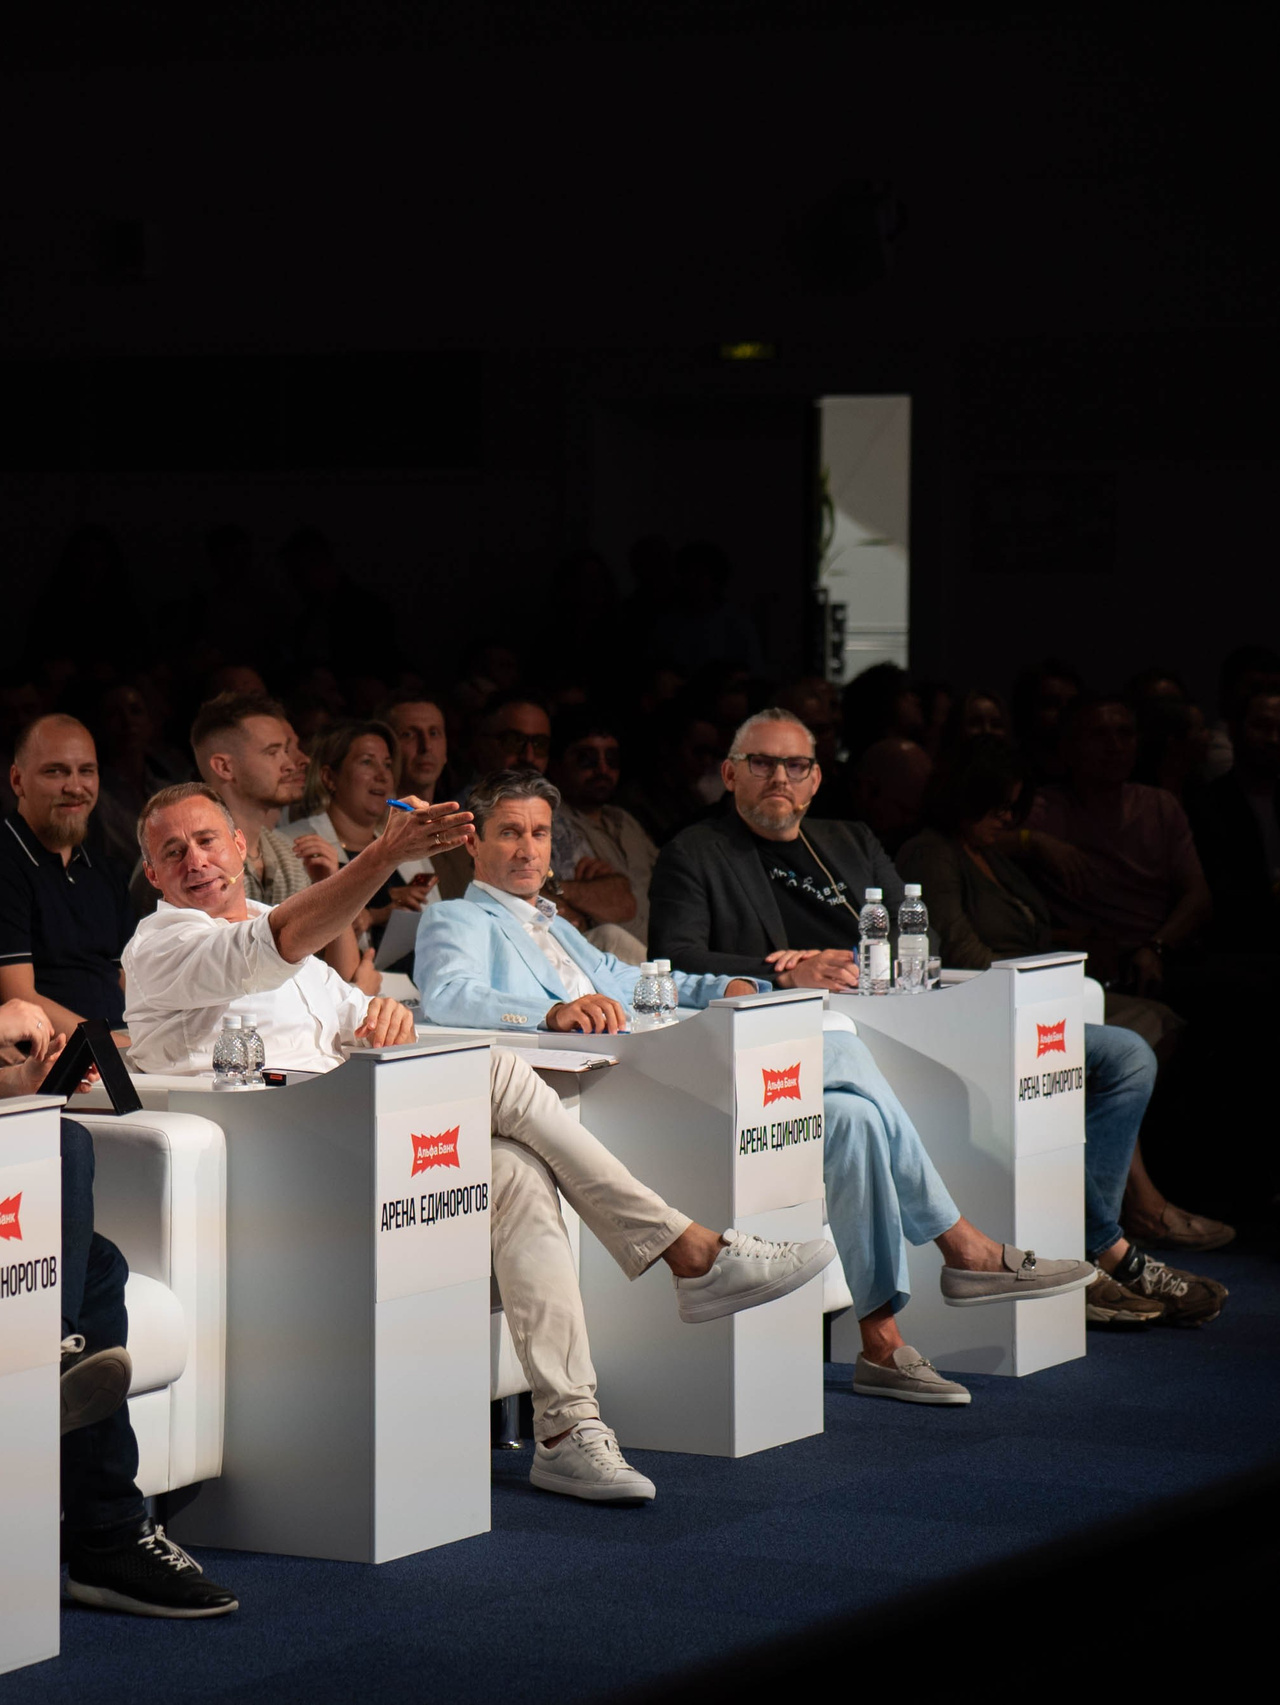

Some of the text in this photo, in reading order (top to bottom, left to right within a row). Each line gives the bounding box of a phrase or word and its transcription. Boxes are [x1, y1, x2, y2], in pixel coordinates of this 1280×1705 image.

[1019, 1067, 1083, 1101] АРЕНА ЕДИНОРОГОВ
[417, 1142, 455, 1160] Альфа Банк
[740, 1114, 822, 1155] АРЕНА ЕДИНОРОГОВ
[381, 1183, 488, 1232] АРЕНА ЕДИНОРОГОВ
